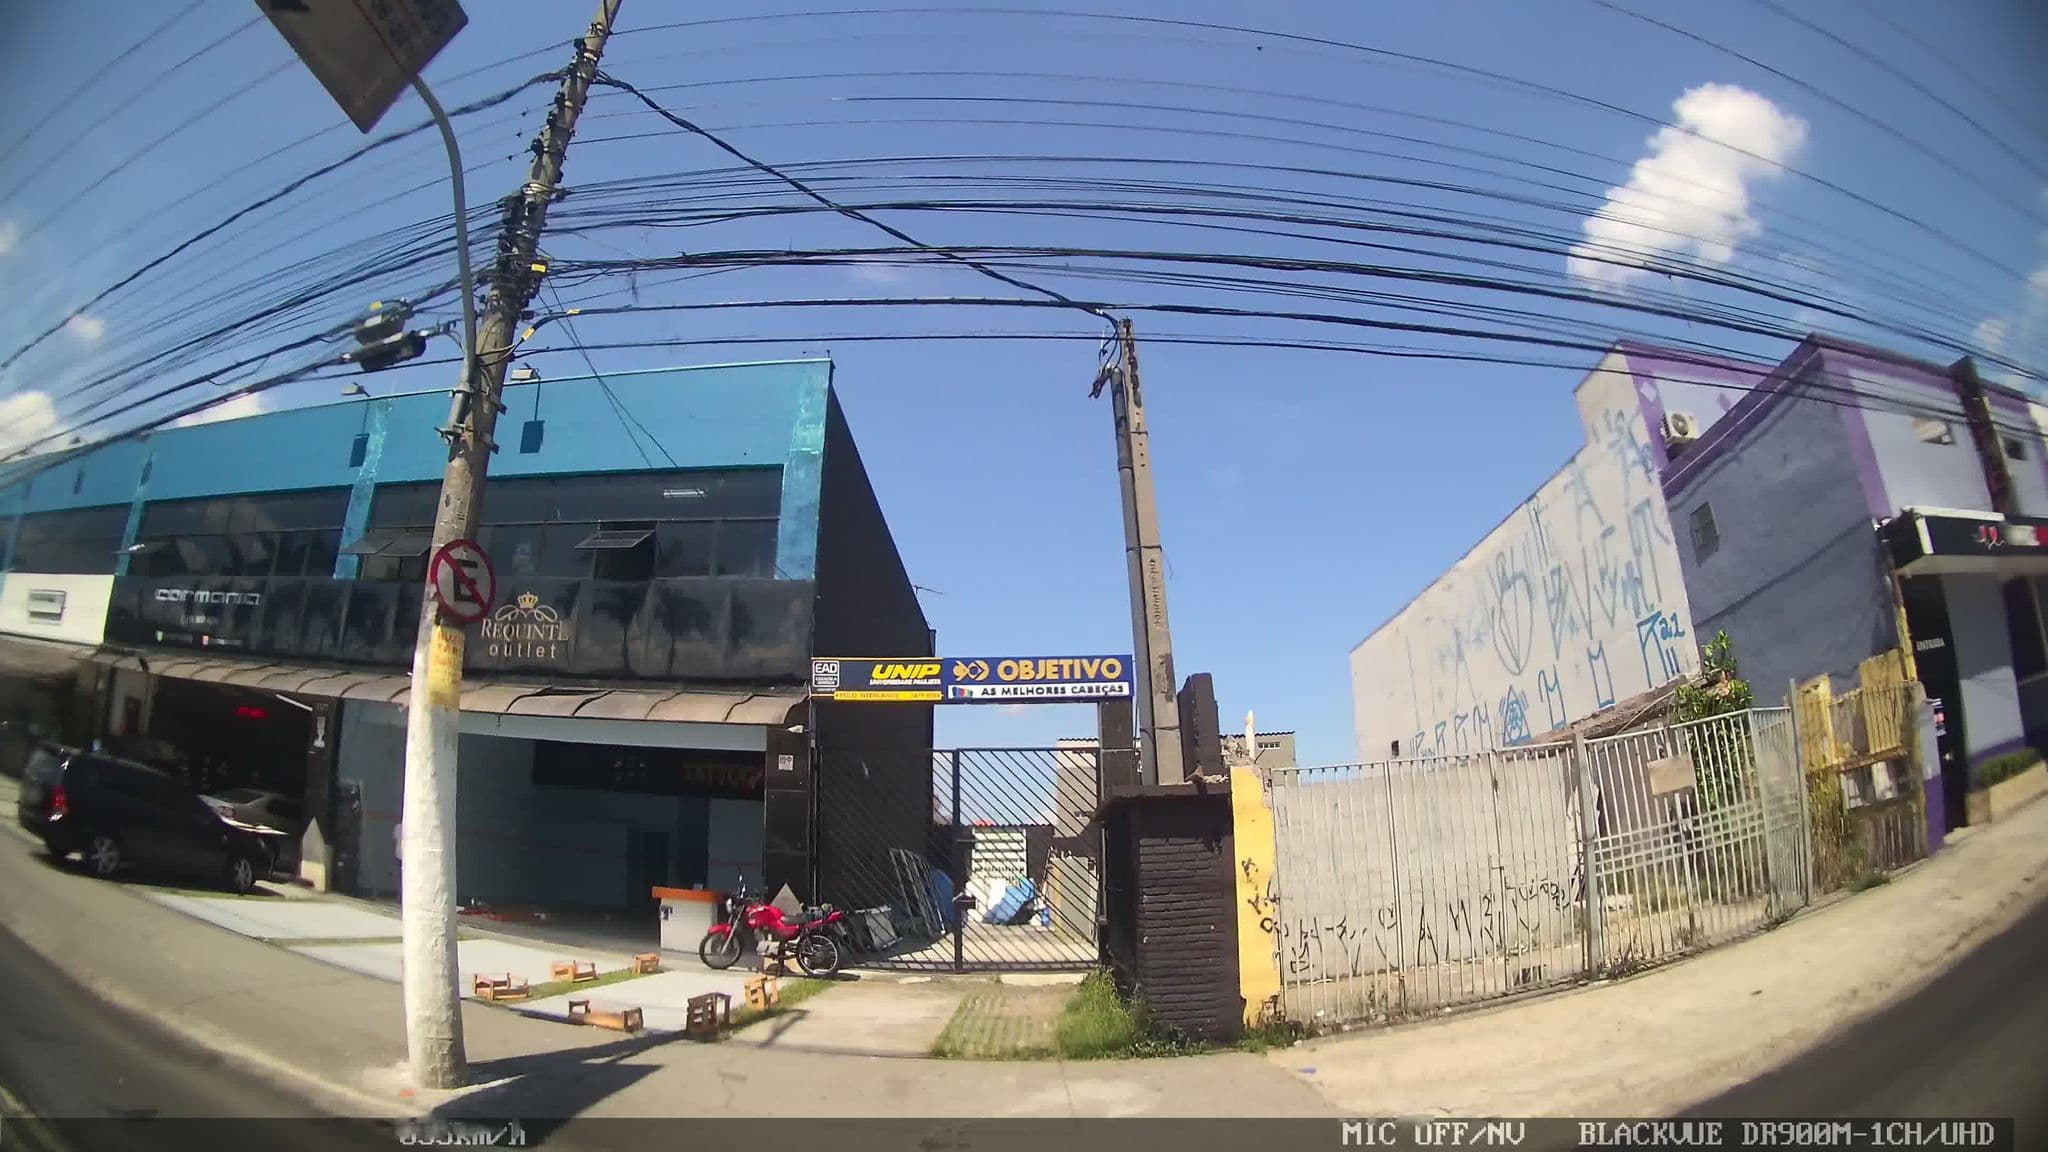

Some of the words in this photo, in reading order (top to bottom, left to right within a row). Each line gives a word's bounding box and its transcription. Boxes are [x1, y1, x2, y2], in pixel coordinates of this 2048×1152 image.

[453, 557, 479, 602] E
[489, 642, 555, 659] outlet
[815, 663, 838, 674] EAD
[872, 664, 941, 679] UNIP
[997, 658, 1122, 681] OBJETIVO
[981, 687, 996, 696] AS
[1001, 686, 1066, 696] MELHORES
[1071, 684, 1123, 695] CABEÇAS
